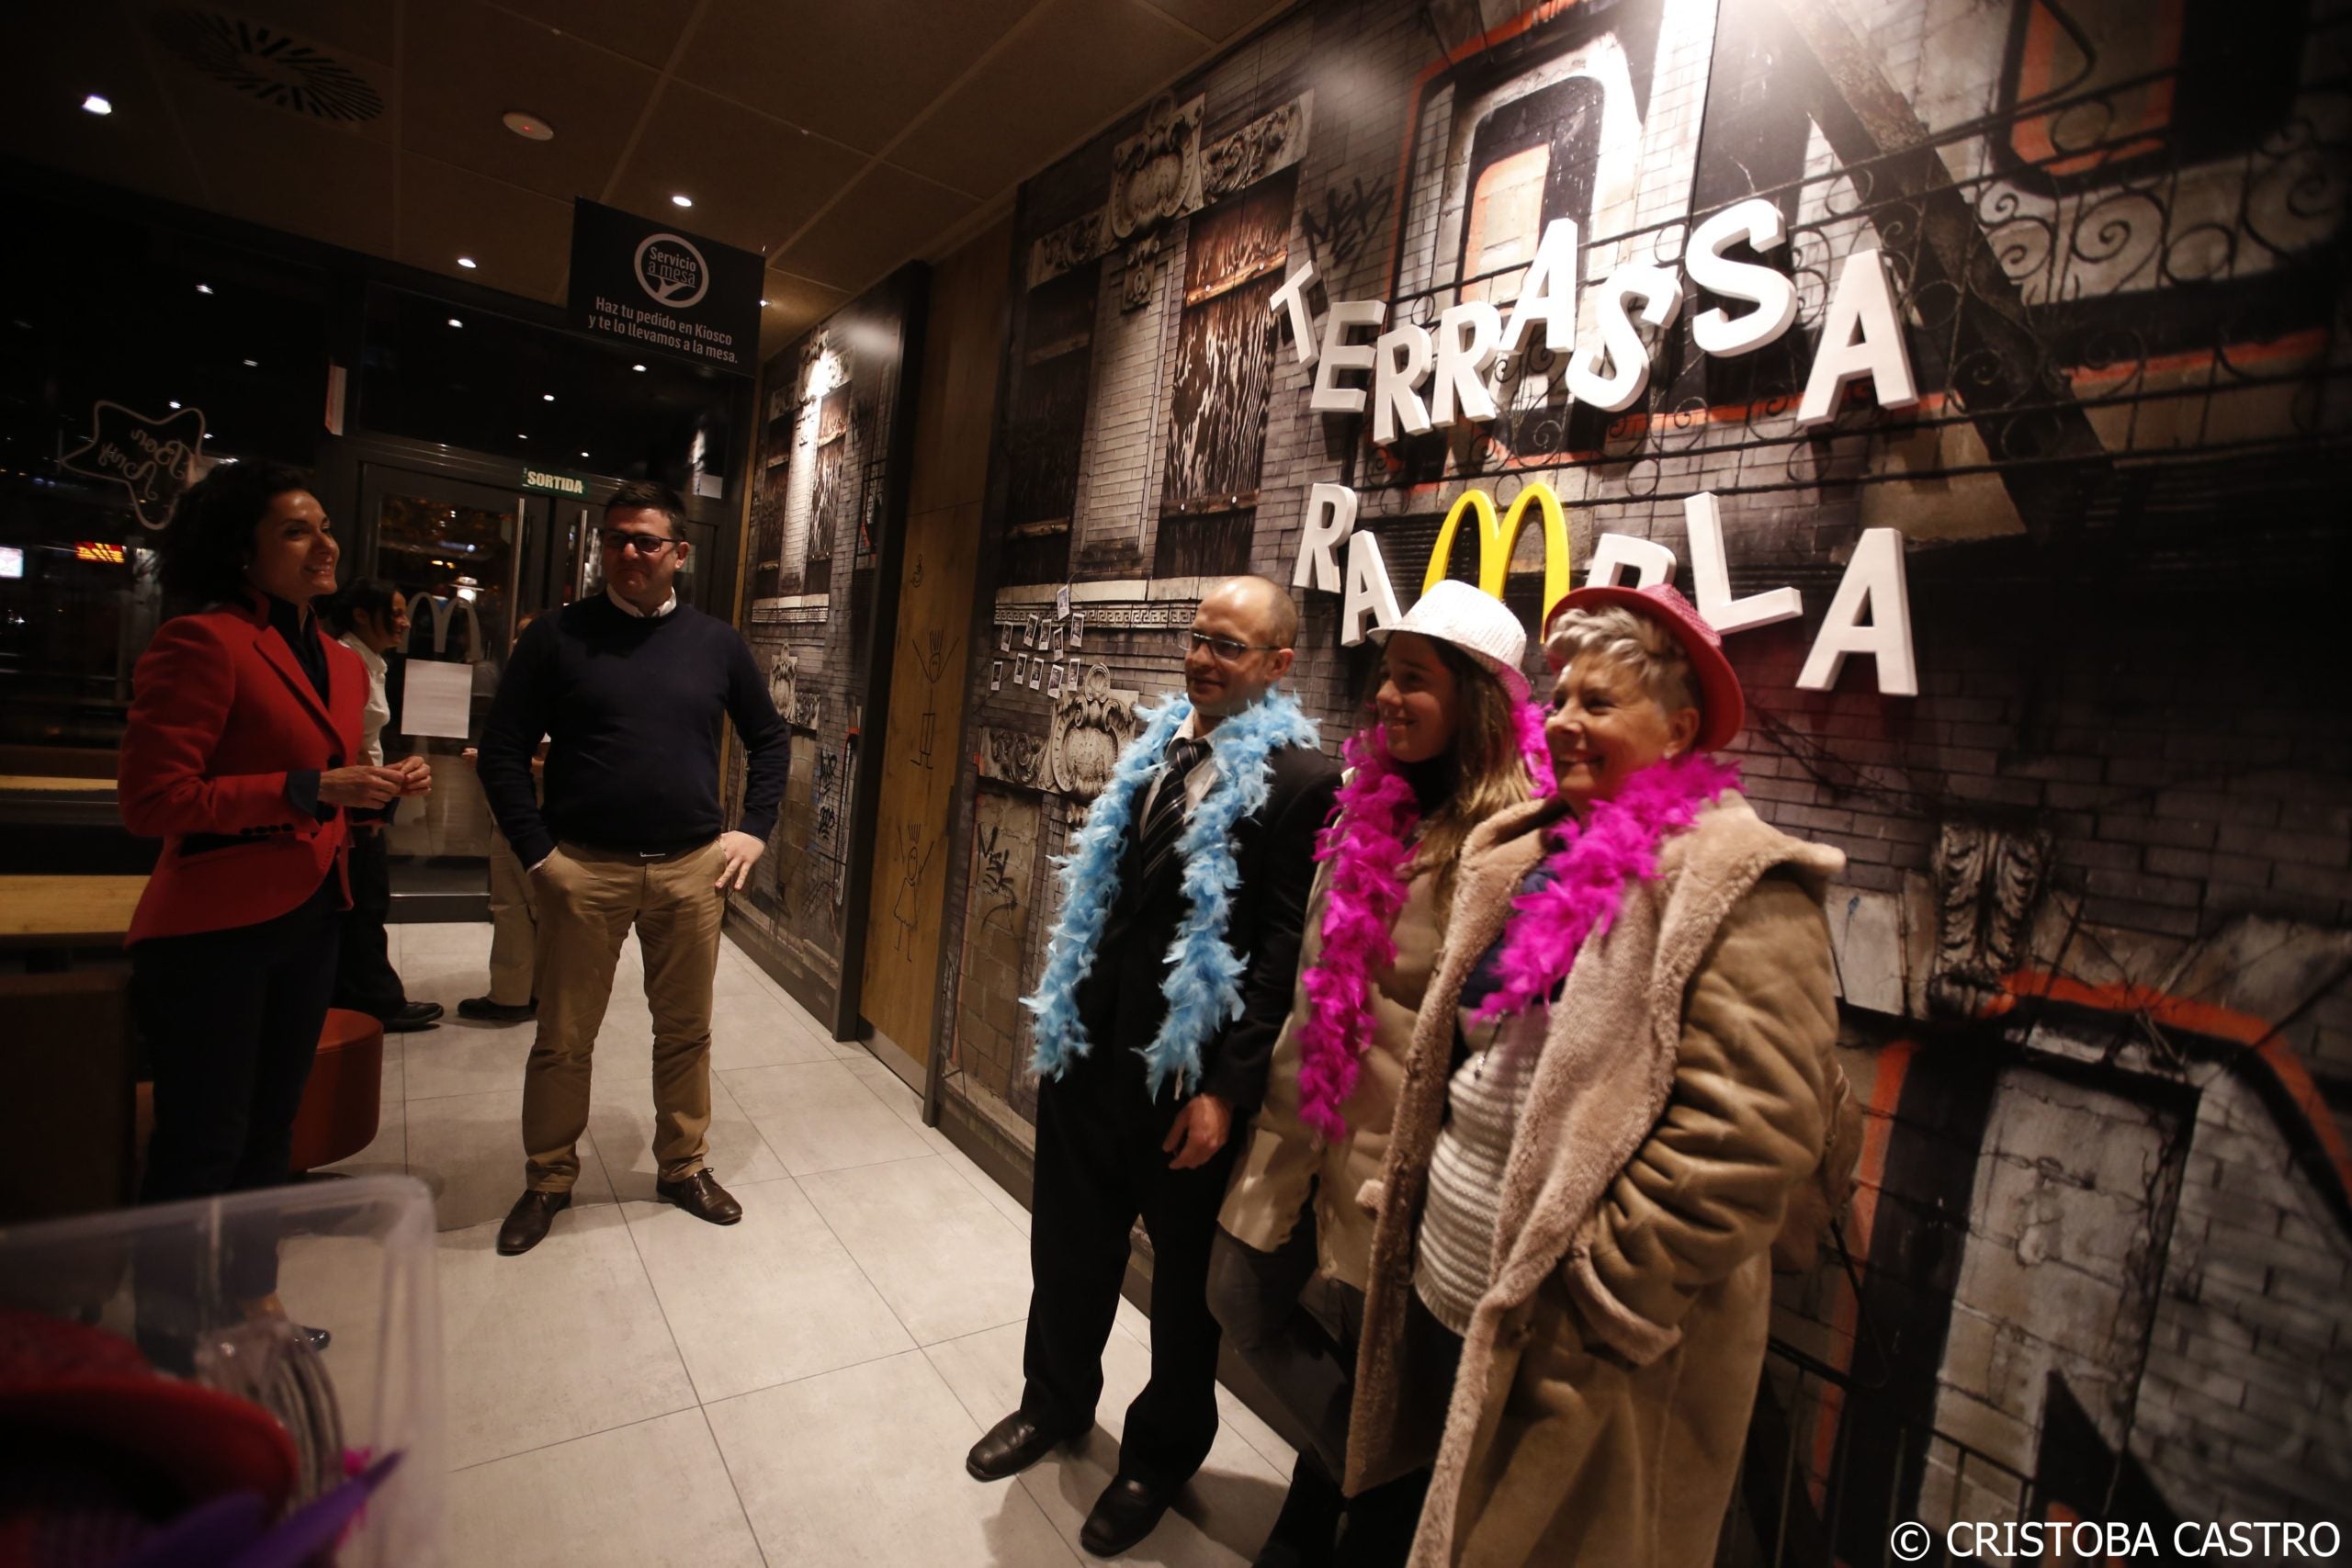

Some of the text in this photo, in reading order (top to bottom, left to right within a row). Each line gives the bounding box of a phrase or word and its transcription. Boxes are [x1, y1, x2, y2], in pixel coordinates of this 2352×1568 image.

[648, 260, 696, 286] a mesa
[649, 245, 696, 272] Servicio
[588, 314, 739, 364] y te lo llevamos a la mesa.
[595, 296, 732, 345] Haz tu pedido en Kiosco
[1269, 198, 1919, 445] TERRASSA
[526, 470, 583, 494] SORTIDA
